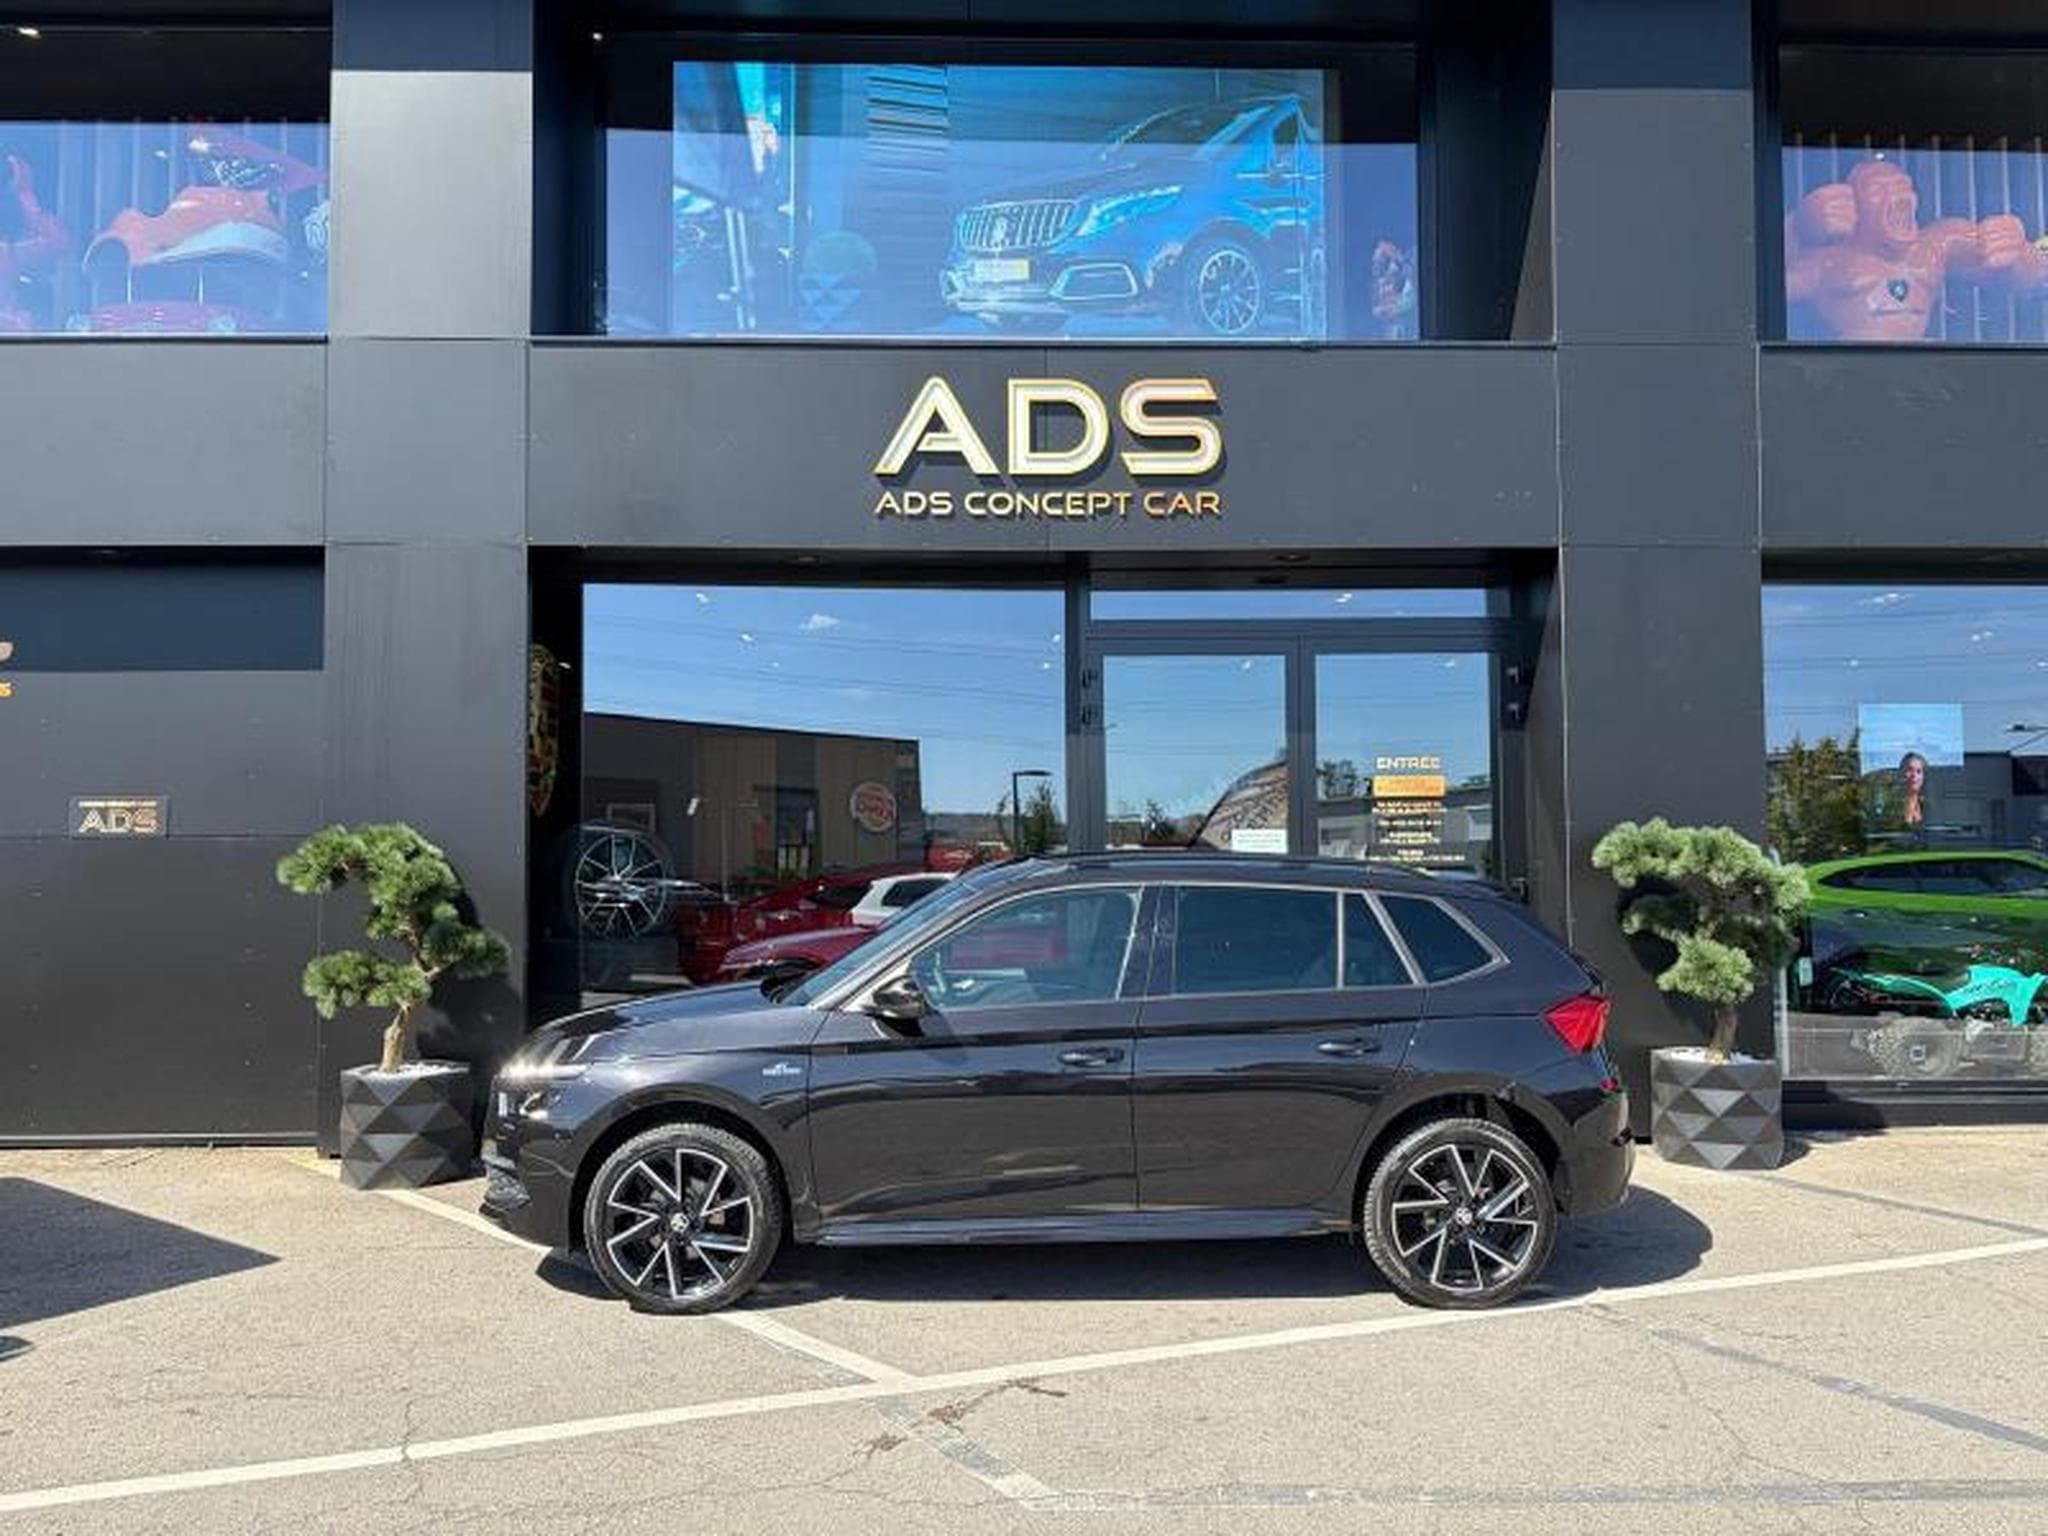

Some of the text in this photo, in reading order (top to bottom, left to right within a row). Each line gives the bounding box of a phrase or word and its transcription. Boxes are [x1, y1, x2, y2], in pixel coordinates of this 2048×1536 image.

[874, 376, 1222, 475] ADS
[874, 491, 1221, 515] ADS CONCEPT CAR
[79, 808, 157, 833] ADS
